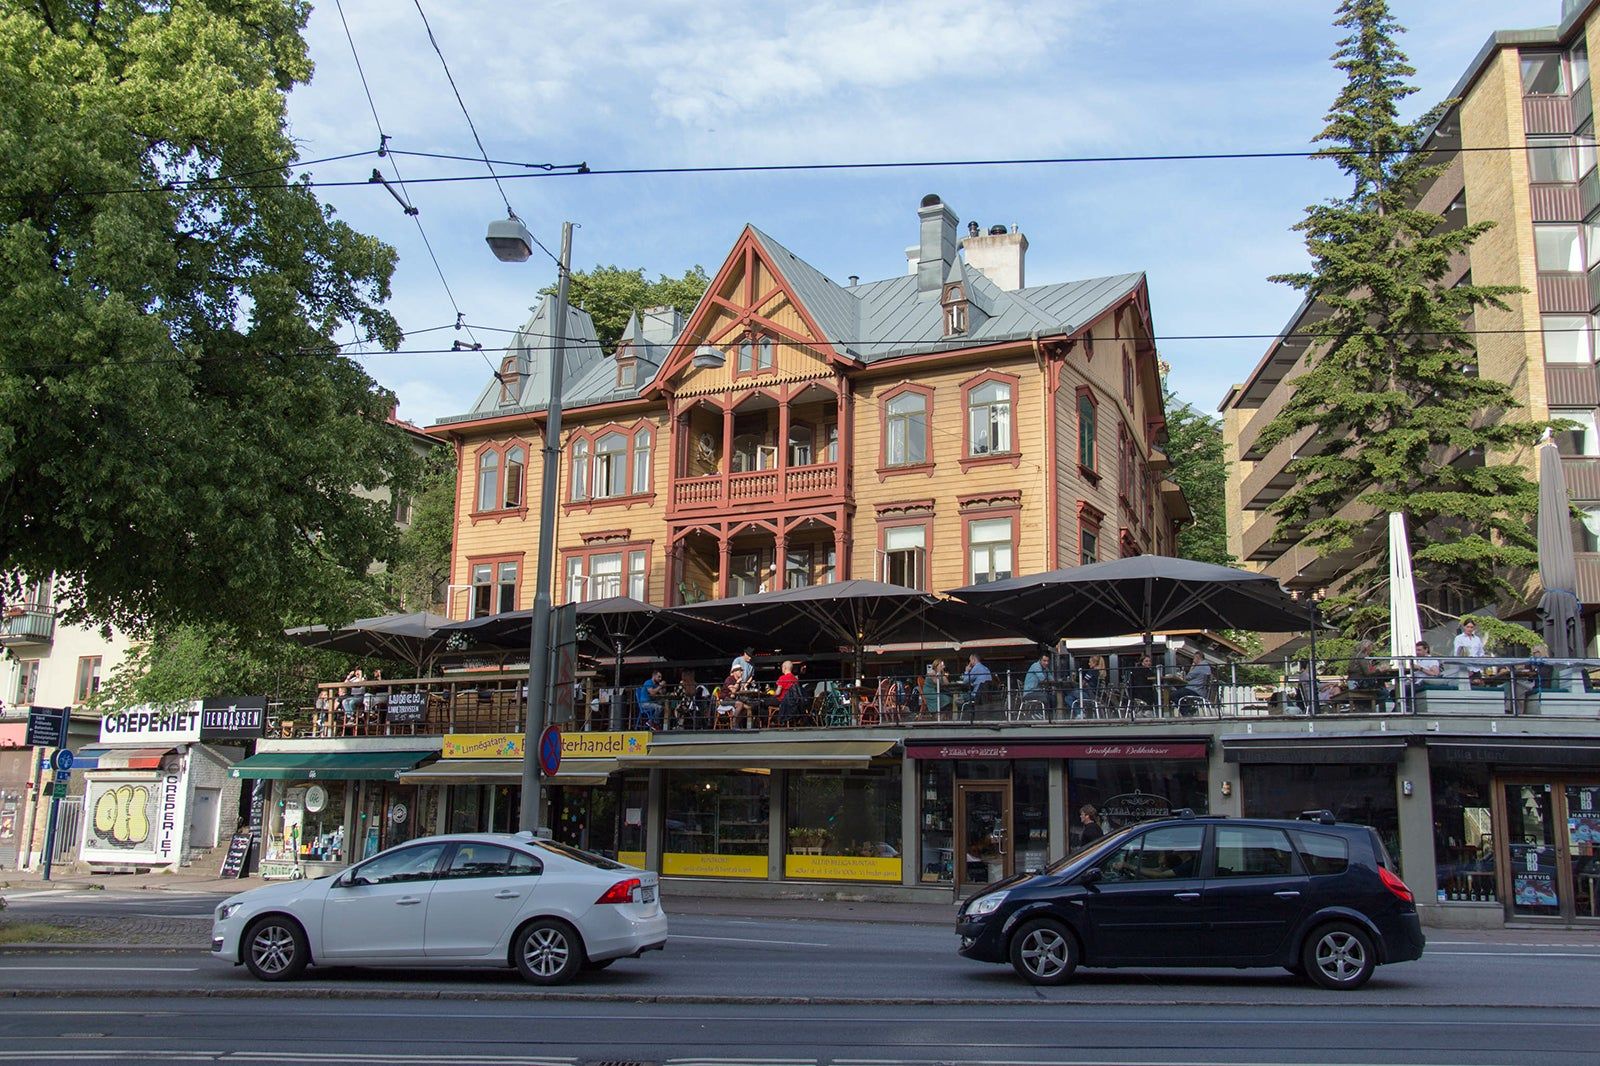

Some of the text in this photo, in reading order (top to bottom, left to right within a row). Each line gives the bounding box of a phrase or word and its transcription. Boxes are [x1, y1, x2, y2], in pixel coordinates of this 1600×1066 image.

[389, 693, 420, 704] LUNCH
[105, 711, 200, 733] CREPERIET
[206, 711, 259, 726] TERRASSEN
[462, 735, 624, 754] Linnégatans terhandel
[161, 775, 178, 858] CREPERIET
